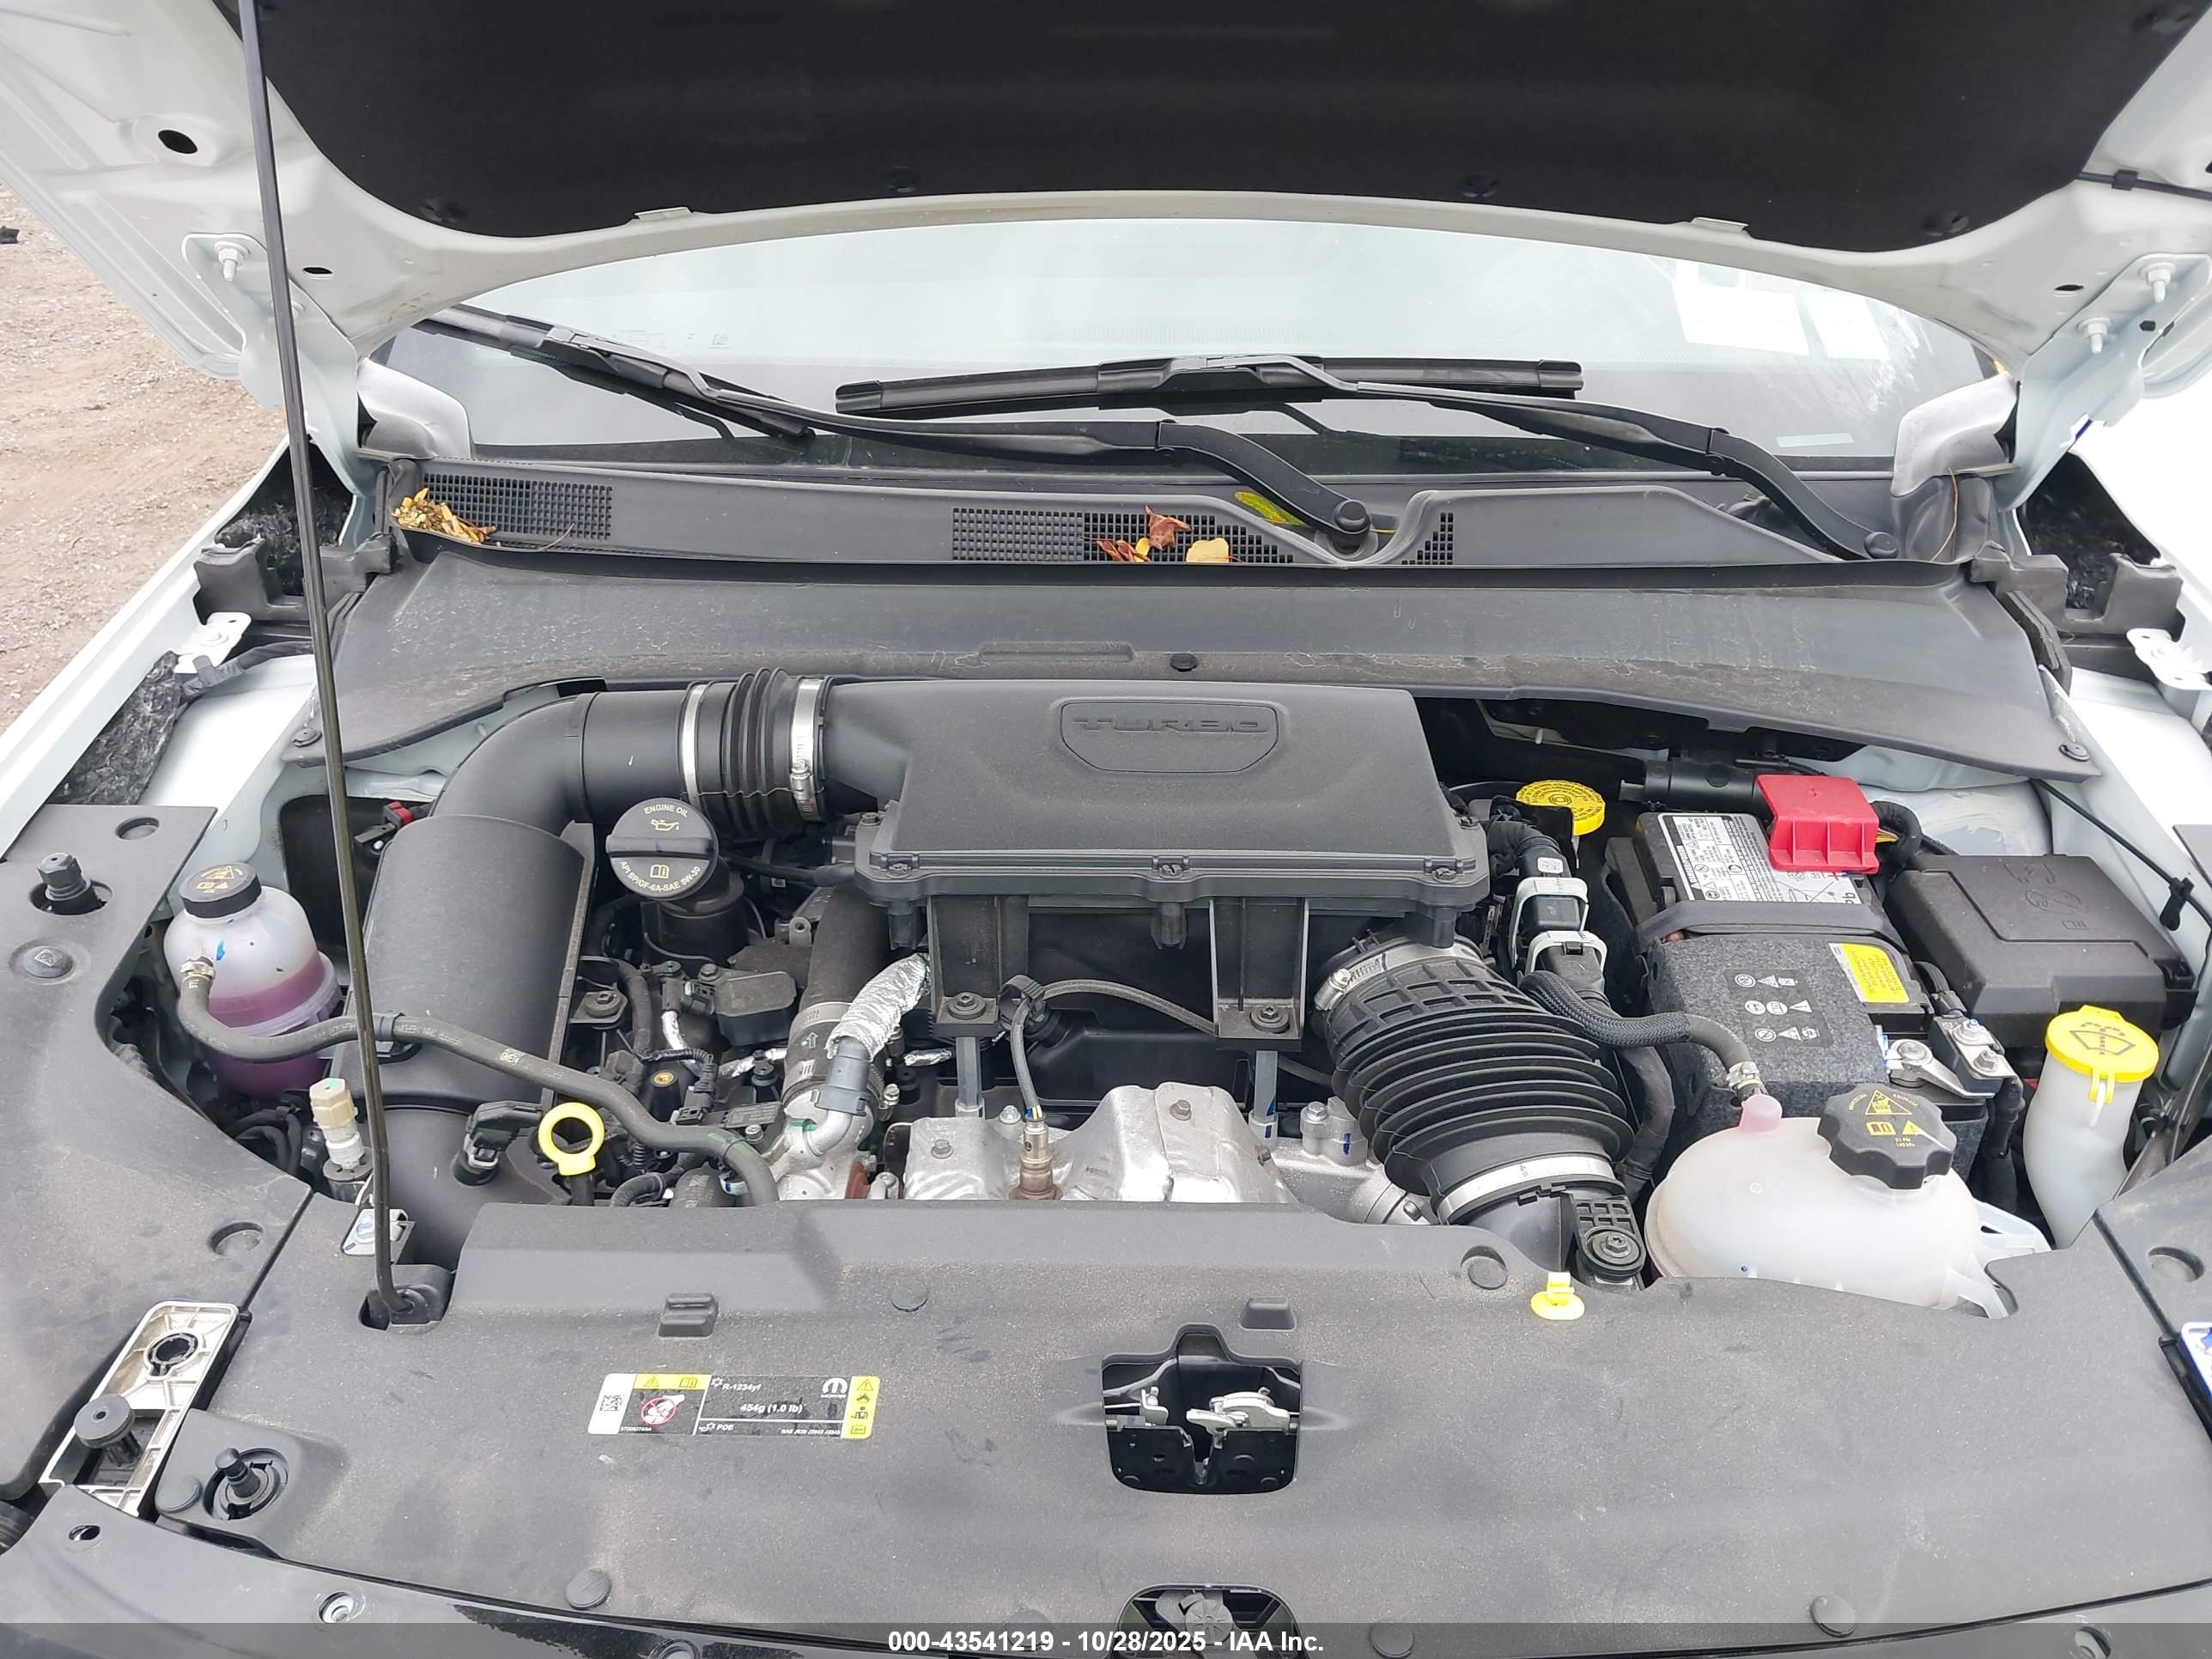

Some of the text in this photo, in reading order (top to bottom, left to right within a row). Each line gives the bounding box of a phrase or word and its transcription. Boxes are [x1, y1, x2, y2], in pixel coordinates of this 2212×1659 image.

[1073, 719, 1267, 734] TURBO
[643, 804, 689, 817] ENGINE OIL
[620, 860, 701, 891] API SP/GF-6A-SAE 5W-30
[722, 1383, 762, 1393] R-1234yf
[740, 1404, 803, 1414] 454g (1.0 lb)
